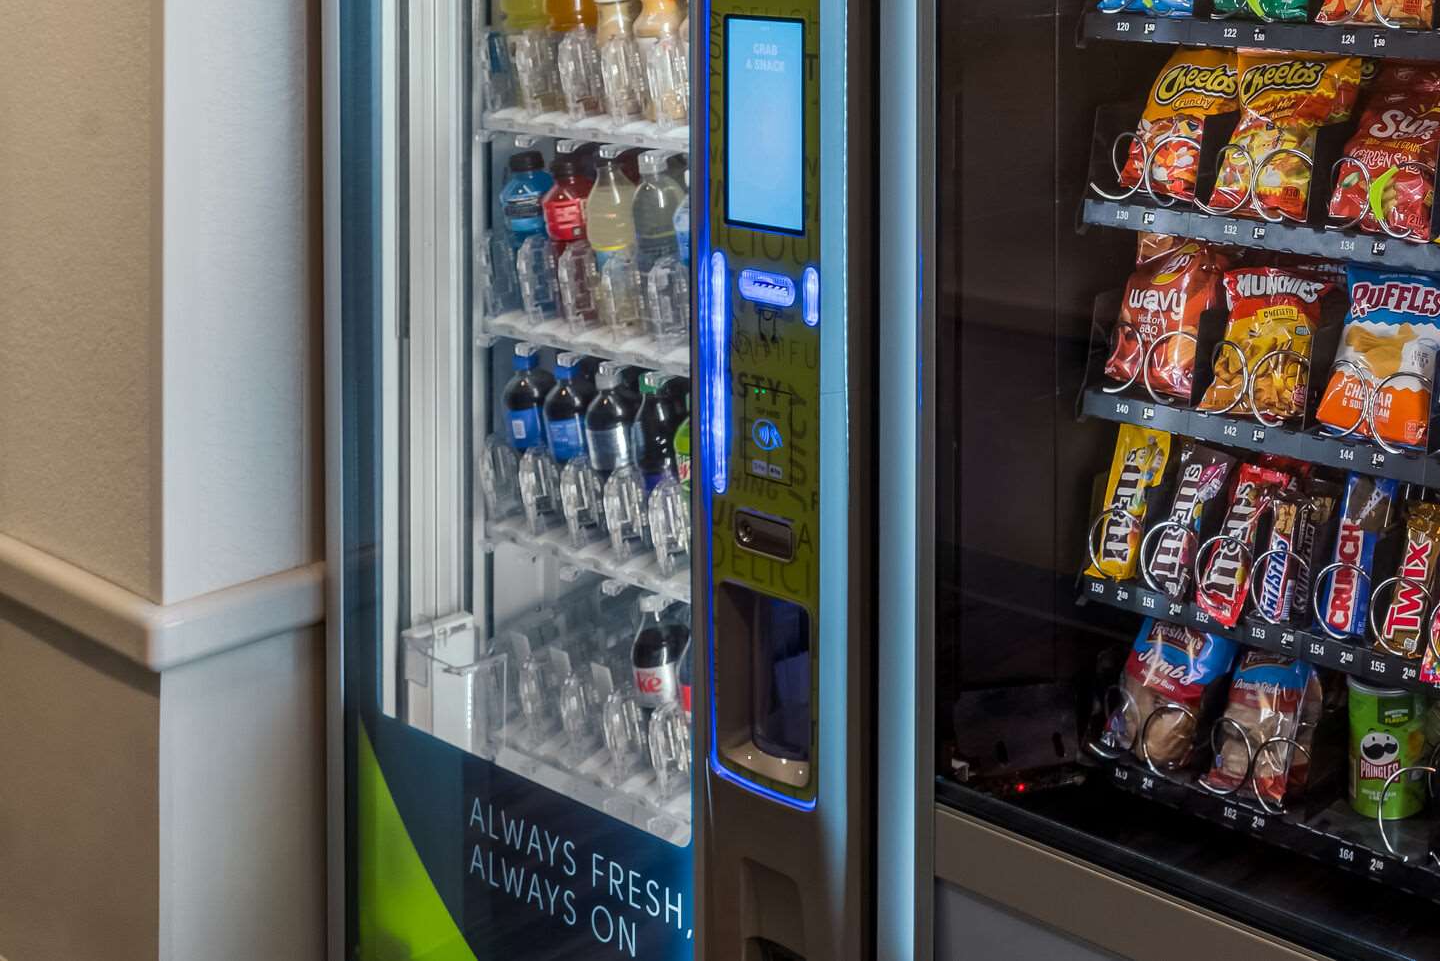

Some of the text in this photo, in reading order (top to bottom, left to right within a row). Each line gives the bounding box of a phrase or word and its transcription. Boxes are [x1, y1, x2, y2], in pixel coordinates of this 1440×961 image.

[1117, 22, 1129, 31] 120
[1224, 28, 1237, 37] 122
[1341, 35, 1355, 44] 124
[1157, 65, 1237, 103] Cheetos
[1242, 61, 1322, 103] Cheetos
[1173, 96, 1215, 110] Crunchy
[1369, 109, 1440, 138] Sun
[1116, 211, 1129, 220] 130
[1224, 225, 1237, 235] 132
[1340, 241, 1354, 251] 134
[1236, 274, 1323, 303] MUNCHIES
[1129, 289, 1187, 320] wavy
[1116, 404, 1128, 414] 140
[1224, 427, 1236, 436] 142
[1340, 450, 1354, 460] 144
[1091, 583, 1104, 593] 150
[1142, 597, 1155, 608] 151
[1197, 612, 1209, 623] 152
[1252, 628, 1266, 639] 153
[1310, 643, 1324, 655] 154
[1371, 661, 1385, 672] 155
[1360, 758, 1400, 781] PRINGLES
[1224, 807, 1237, 819] 162
[1339, 848, 1353, 861] 164
[469, 797, 693, 939] ALWAYS FRESH,
[470, 845, 637, 958] ALWAYS ON
